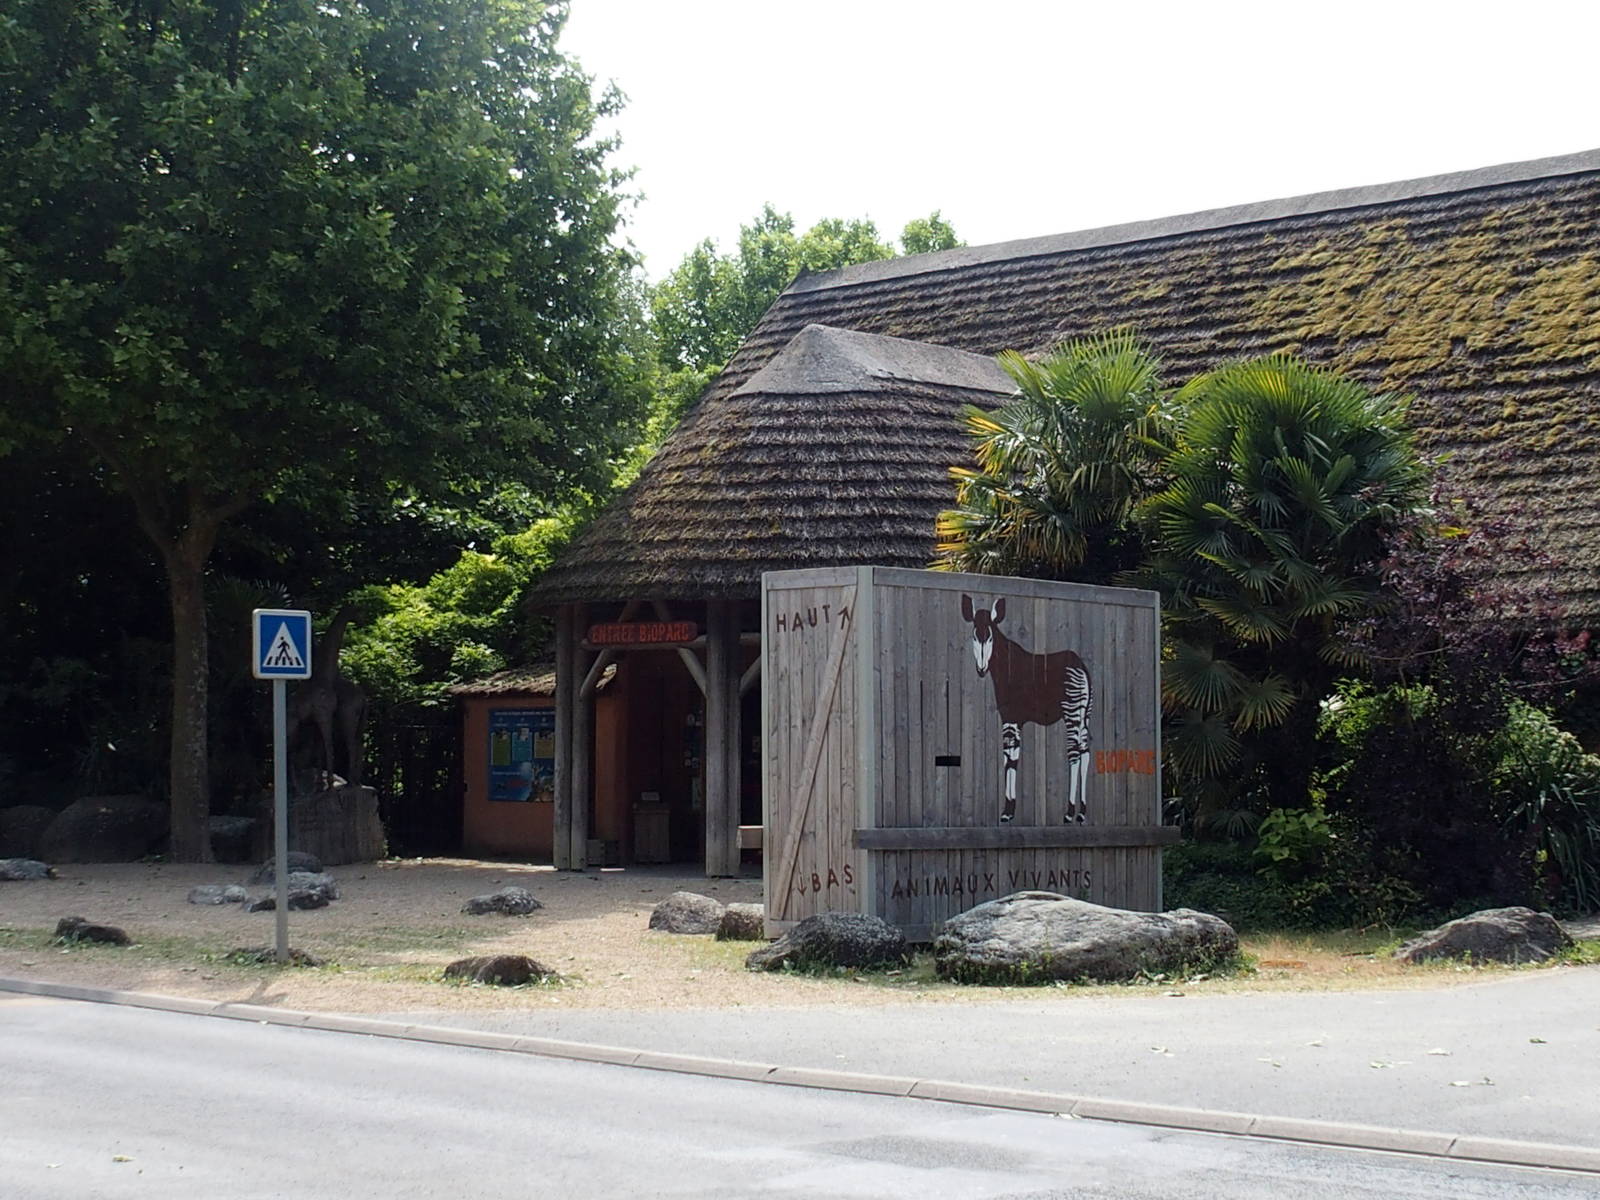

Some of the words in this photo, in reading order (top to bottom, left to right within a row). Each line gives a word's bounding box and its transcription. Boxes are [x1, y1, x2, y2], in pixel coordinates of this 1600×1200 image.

[776, 605, 831, 633] HAUT
[811, 864, 853, 892] BAS
[891, 873, 995, 899] ANIMAUX
[1008, 870, 1092, 889] VIVANTS
